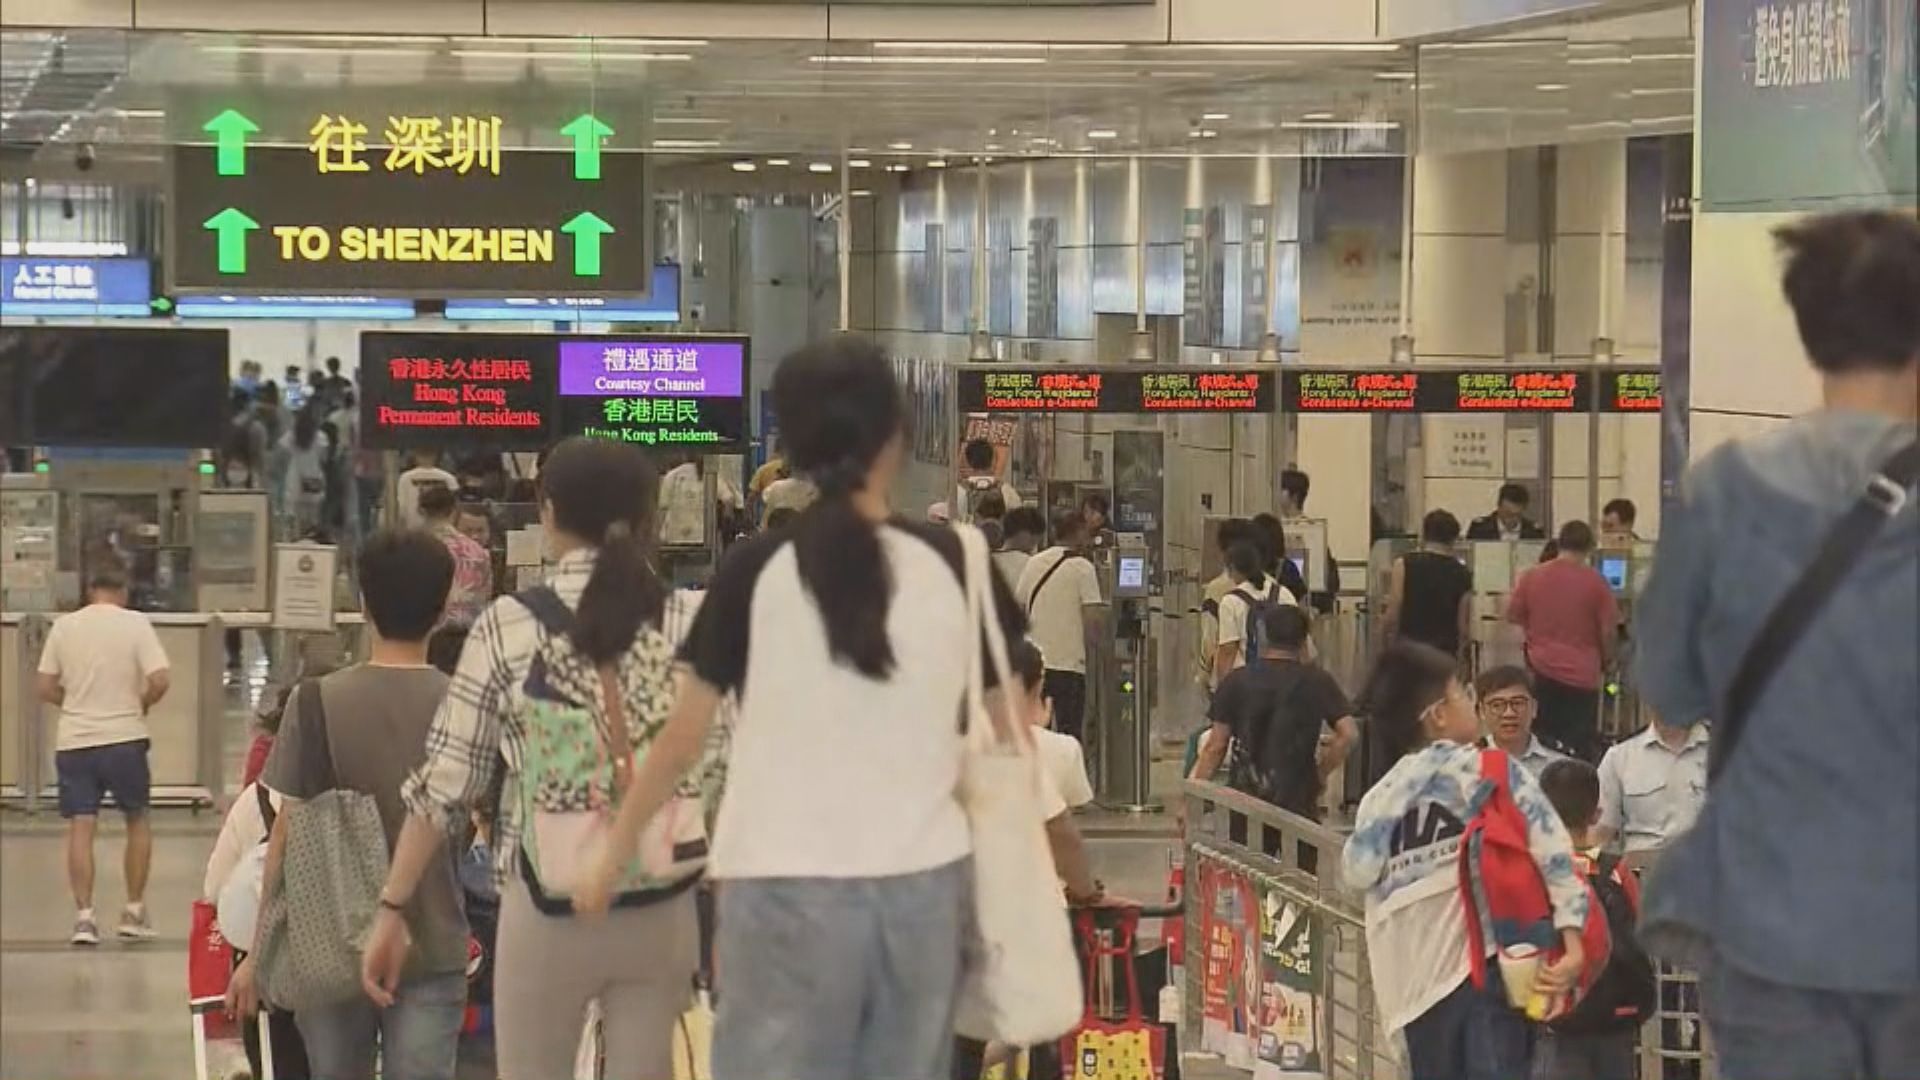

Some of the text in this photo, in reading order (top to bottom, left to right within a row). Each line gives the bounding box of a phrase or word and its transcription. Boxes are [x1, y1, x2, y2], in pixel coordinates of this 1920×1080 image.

[309, 114, 502, 175] 往 深圳
[273, 226, 553, 262] TO SHENZHEN
[389, 358, 532, 381] 香港永久性居民
[602, 347, 698, 372] 禮遇通道
[413, 383, 506, 405] Hong Kong
[594, 377, 705, 393] Courtesy Channel
[986, 387, 1013, 398] Hong
[1015, 387, 1041, 398] Kong
[1143, 388, 1170, 398] Hong
[1173, 387, 1199, 399] Kong
[1301, 387, 1328, 398] Hong
[1331, 387, 1356, 398] Kong
[1459, 388, 1487, 398] Hong
[1489, 387, 1516, 399] Kong
[378, 406, 541, 426] Permanent Residents
[603, 398, 699, 423] 香港居民
[621, 427, 656, 445] Kong
[658, 427, 719, 443] Residents
